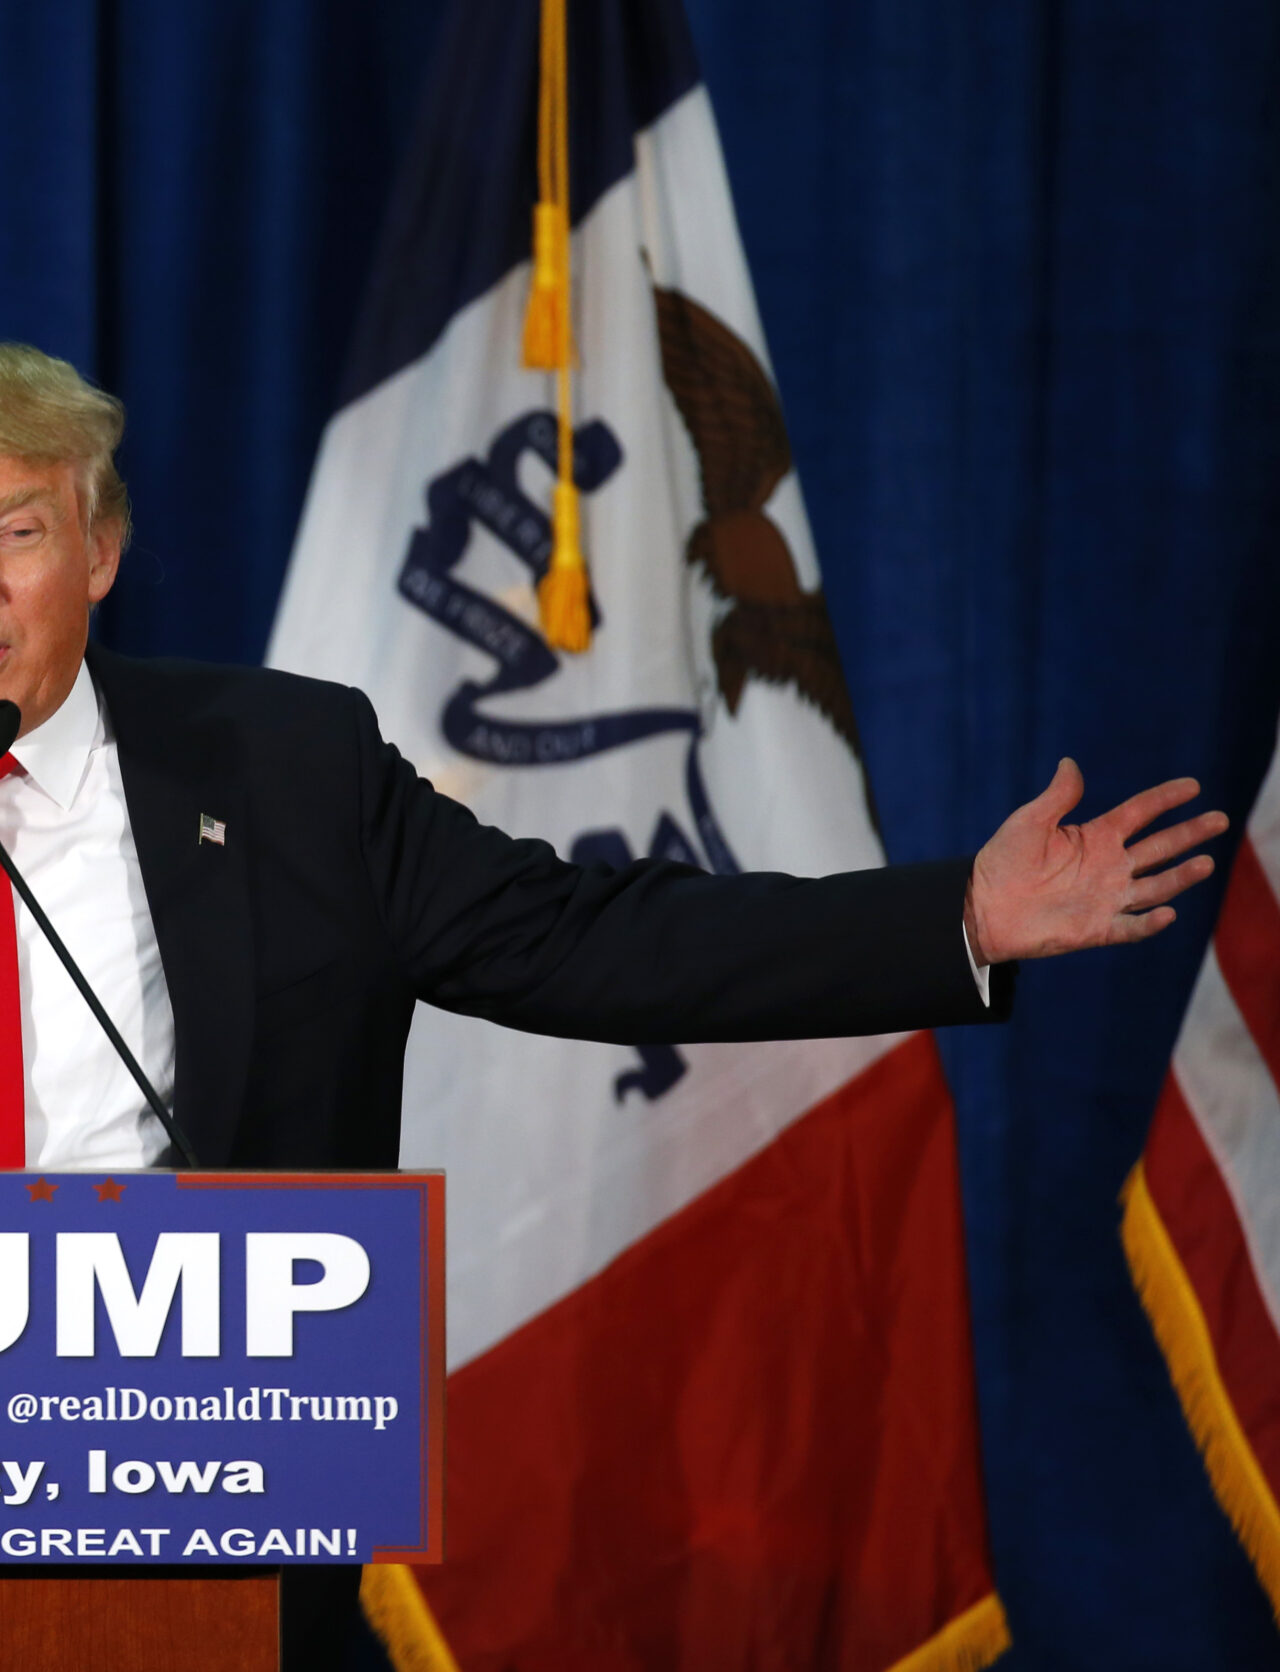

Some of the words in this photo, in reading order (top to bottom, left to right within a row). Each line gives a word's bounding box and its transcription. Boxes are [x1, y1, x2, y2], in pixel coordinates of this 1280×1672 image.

[7, 1386, 399, 1431] @realDonaldTrump
[88, 1448, 265, 1494] Iowa
[0, 1527, 171, 1557] GREAT
[182, 1527, 358, 1557] AGAIN!
